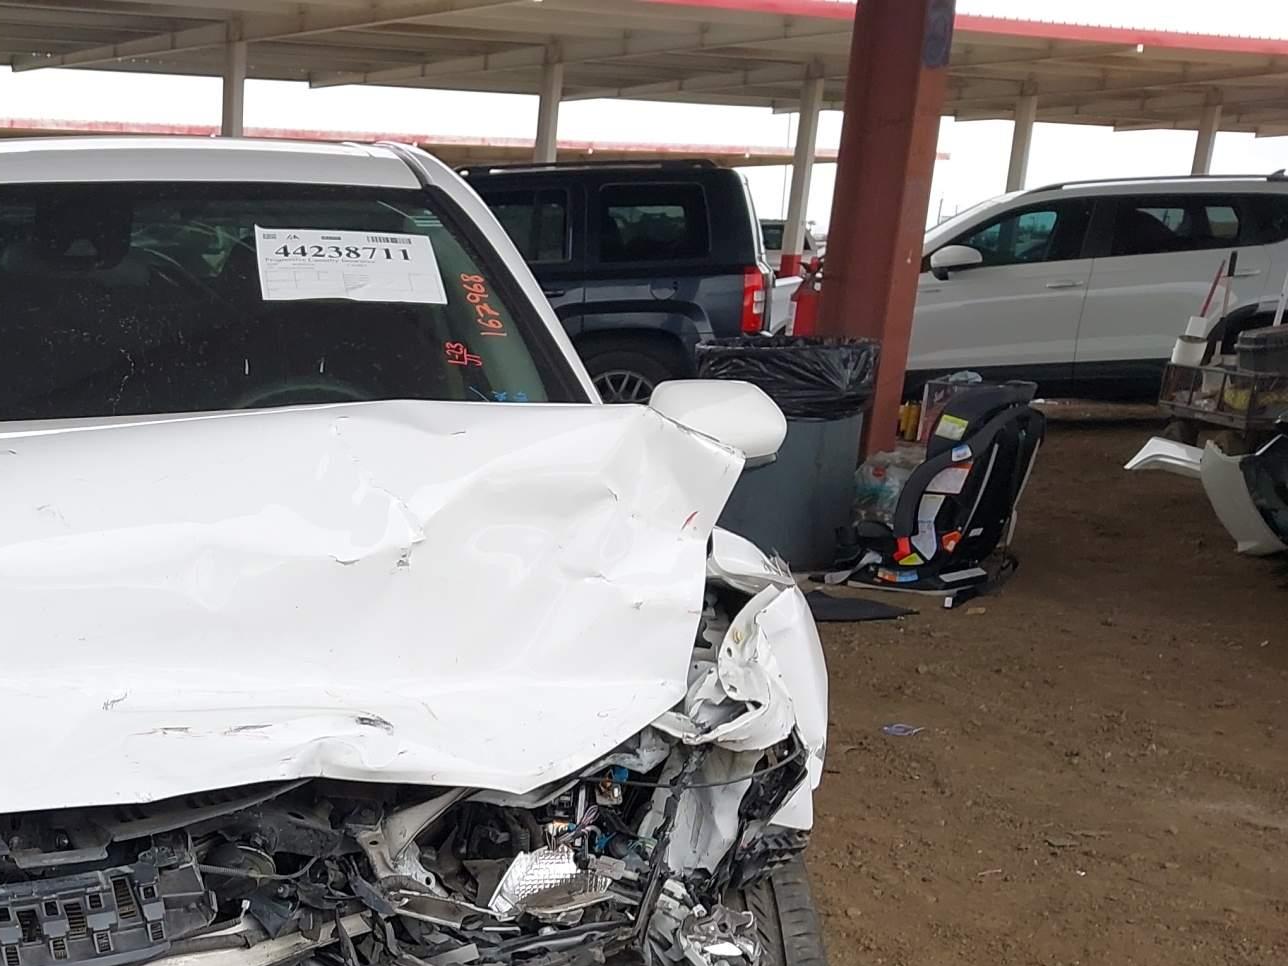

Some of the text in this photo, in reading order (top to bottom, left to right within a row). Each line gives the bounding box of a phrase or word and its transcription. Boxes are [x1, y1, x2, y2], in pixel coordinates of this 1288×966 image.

[275, 244, 410, 261] 44238711
[460, 273, 508, 337] 167968
[445, 341, 468, 364] 1-23
